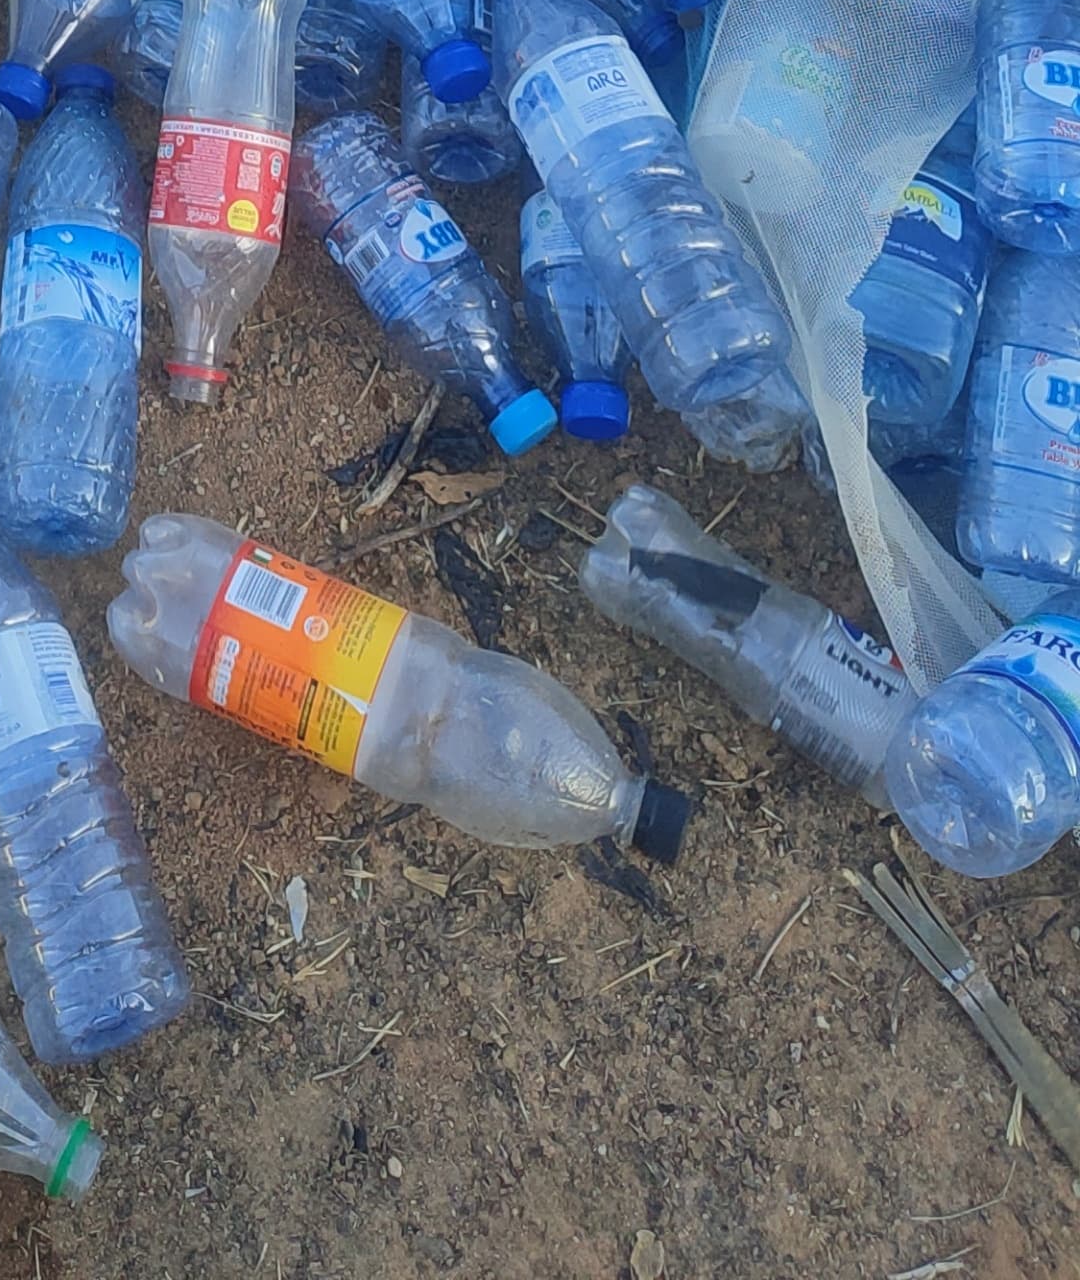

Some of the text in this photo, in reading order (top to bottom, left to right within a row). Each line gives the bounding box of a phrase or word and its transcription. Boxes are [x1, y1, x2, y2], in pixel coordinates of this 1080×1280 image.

[587, 70, 627, 93] ARA
[90, 247, 137, 282] Mr.V
[825, 642, 901, 700] LIGHT
